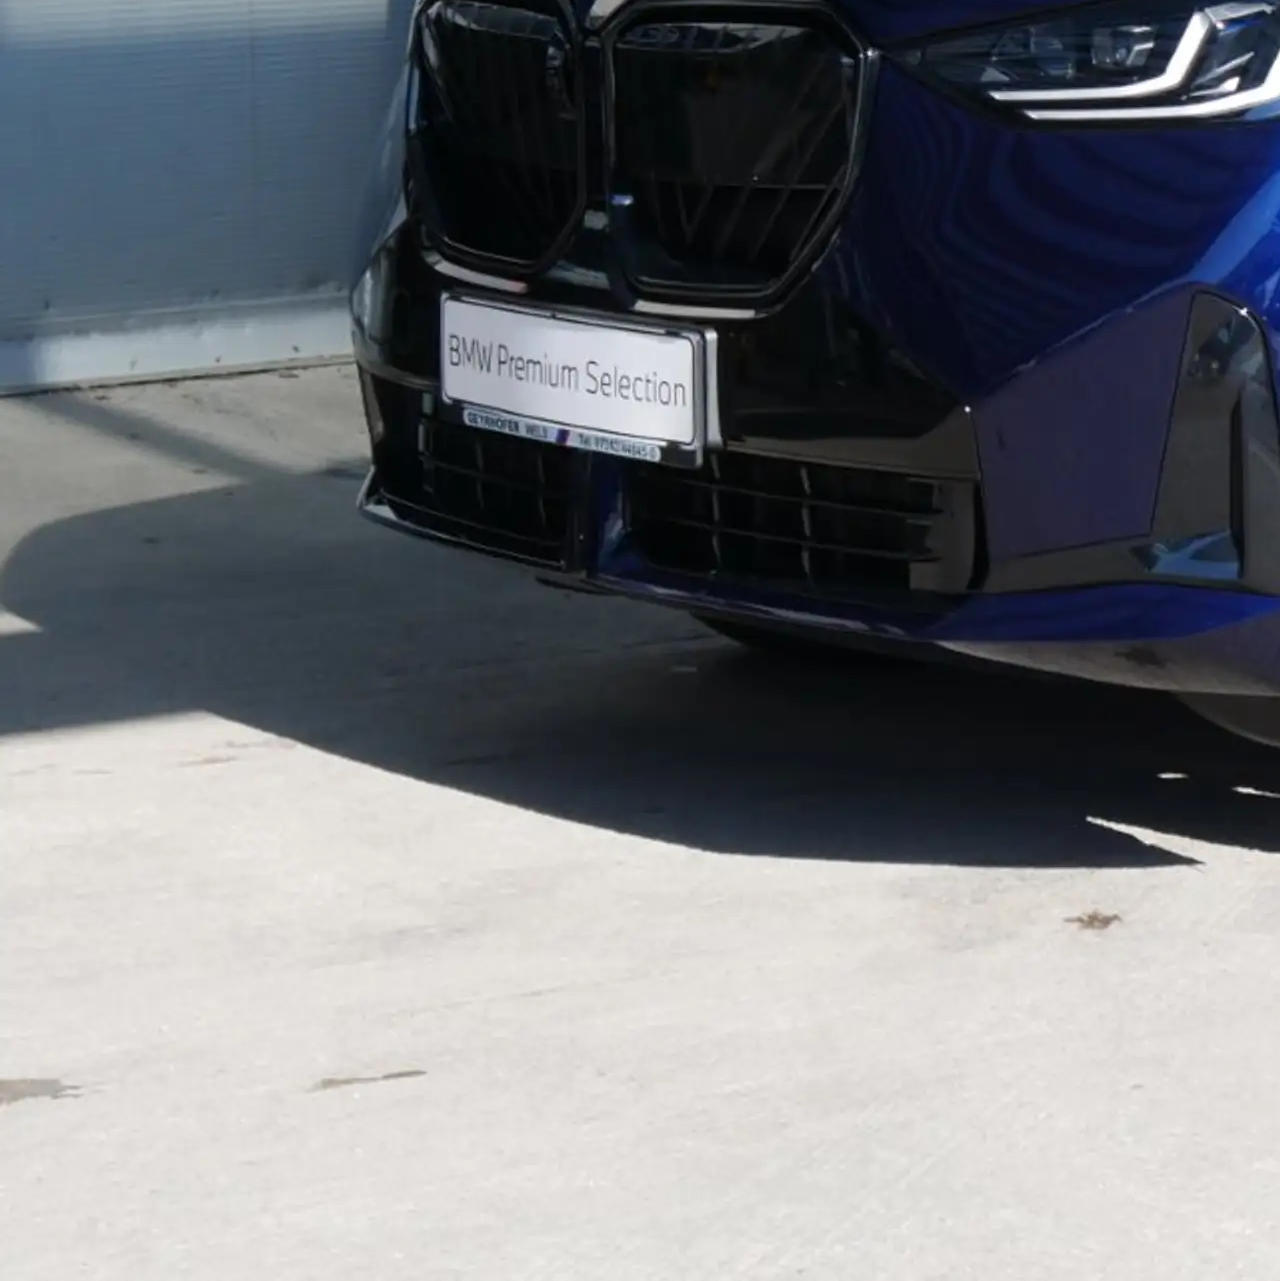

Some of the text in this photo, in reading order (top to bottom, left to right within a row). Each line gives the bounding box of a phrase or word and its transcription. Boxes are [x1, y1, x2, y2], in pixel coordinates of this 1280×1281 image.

[449, 335, 687, 408] BMW Premium Selection
